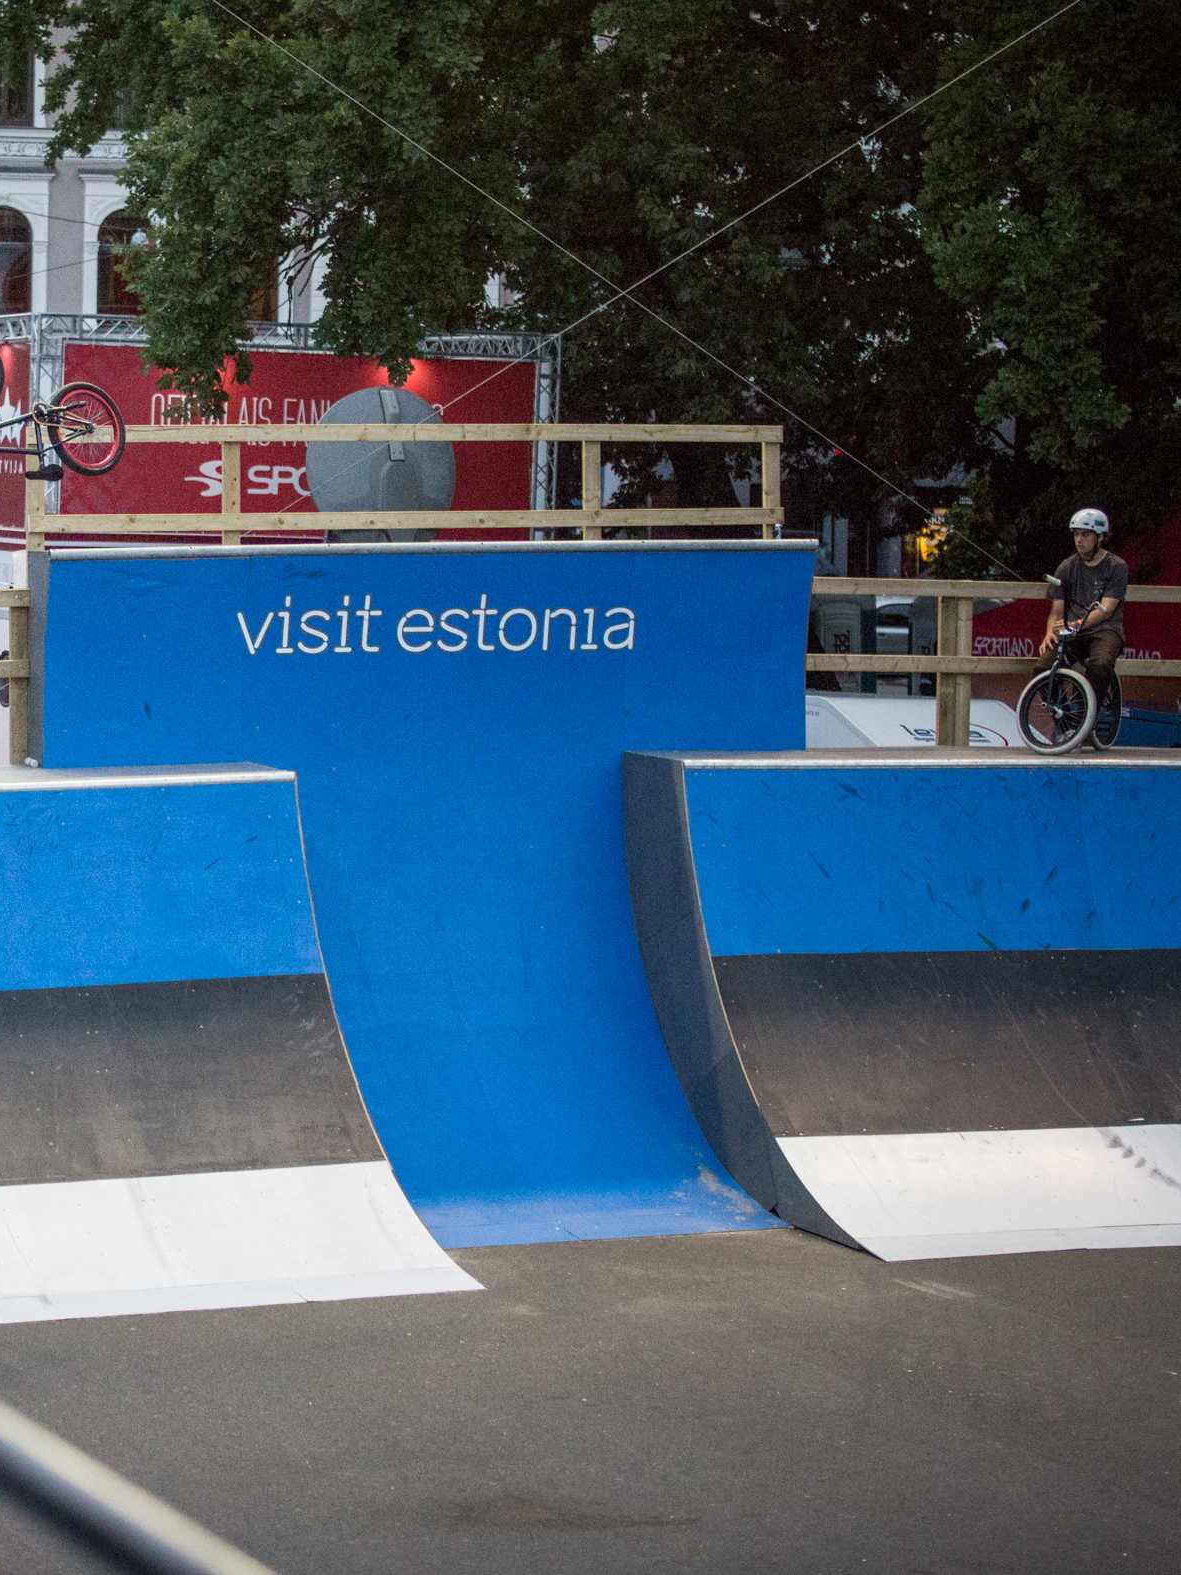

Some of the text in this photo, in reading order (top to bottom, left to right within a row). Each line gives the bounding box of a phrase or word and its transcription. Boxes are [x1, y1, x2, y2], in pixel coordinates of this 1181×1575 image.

[237, 594, 636, 655] visit estonia
[971, 636, 1034, 658] SPORTLAND
